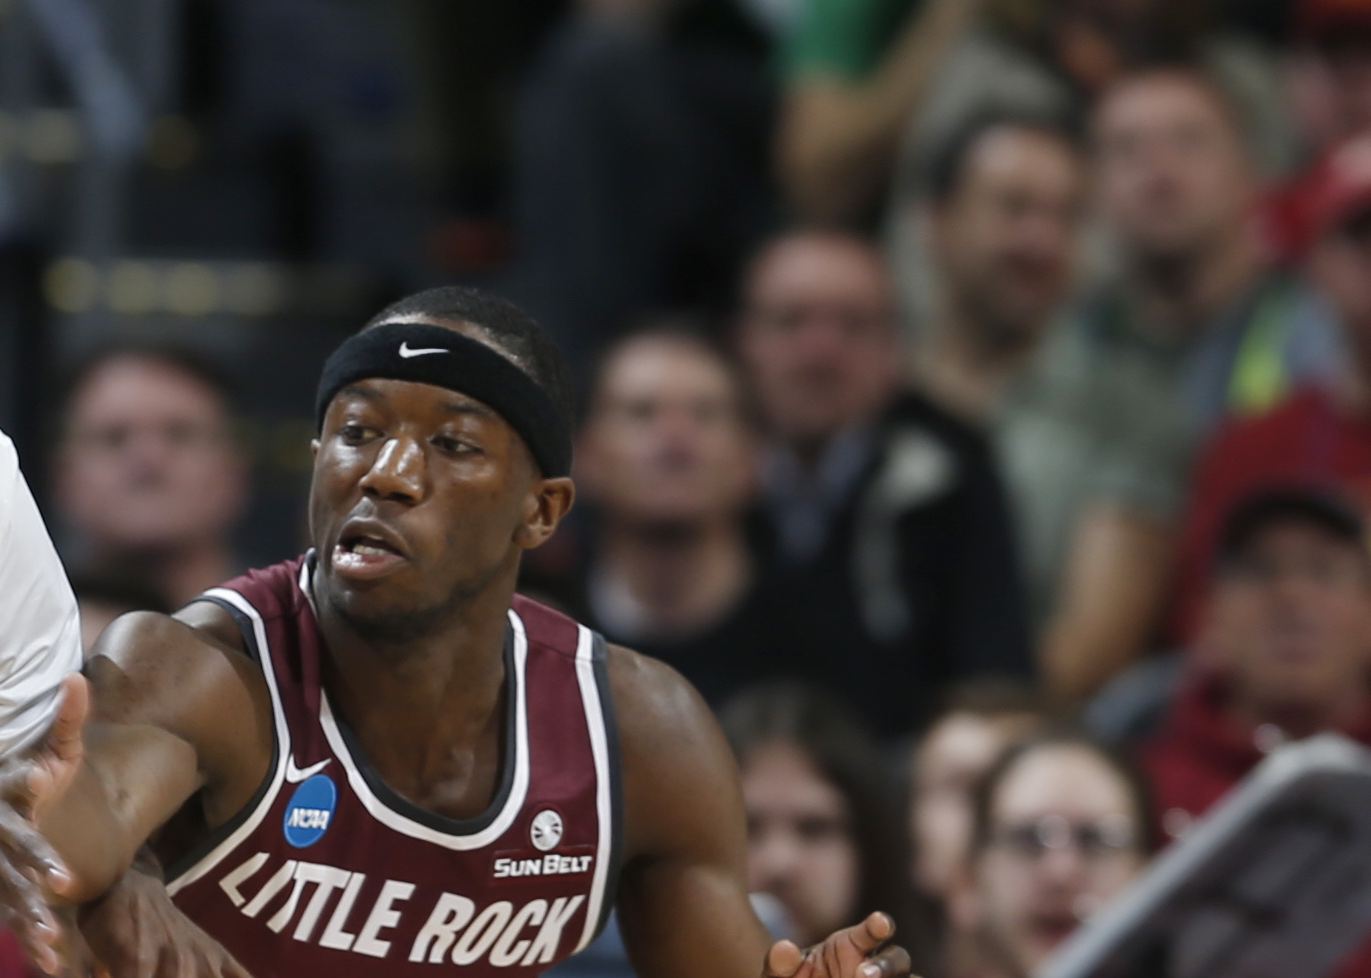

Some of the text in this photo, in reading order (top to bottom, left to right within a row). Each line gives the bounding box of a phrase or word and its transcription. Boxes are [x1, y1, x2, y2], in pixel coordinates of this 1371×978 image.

[287, 807, 330, 830] NCAA
[219, 852, 586, 967] LITTLE ROCK
